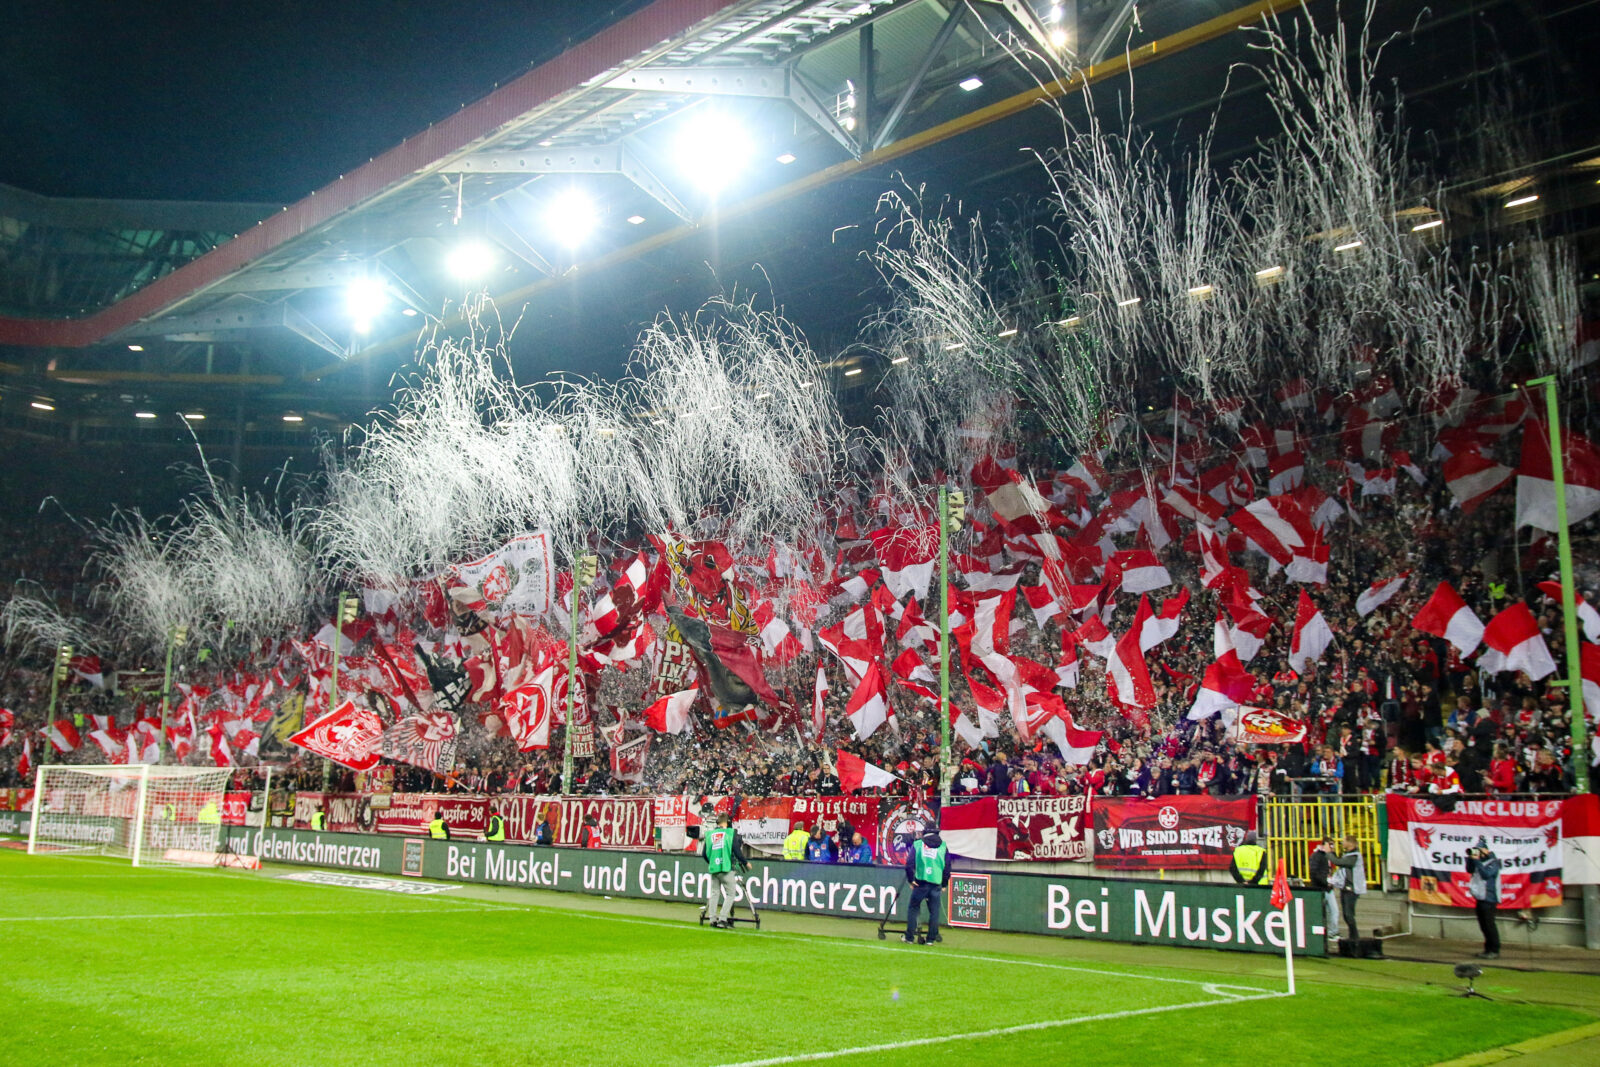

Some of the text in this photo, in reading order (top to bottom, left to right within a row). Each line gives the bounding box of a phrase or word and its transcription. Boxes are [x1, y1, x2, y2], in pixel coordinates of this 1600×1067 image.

[470, 803, 484, 822] '98
[793, 798, 867, 815] Division
[1453, 800, 1540, 817] ANCLUB
[1118, 825, 1223, 849] WIR SIND BETZE
[1440, 833, 1540, 845] Feuer & Flamme
[253, 830, 381, 869] Gelenkschmerzen
[1034, 842, 1085, 857] CONTWIG
[447, 845, 476, 879] Bei
[484, 848, 573, 886] Muskel-
[583, 857, 627, 892] und
[638, 858, 898, 915] Gelenschmerzen
[1047, 883, 1326, 949] Bei Muskel-
